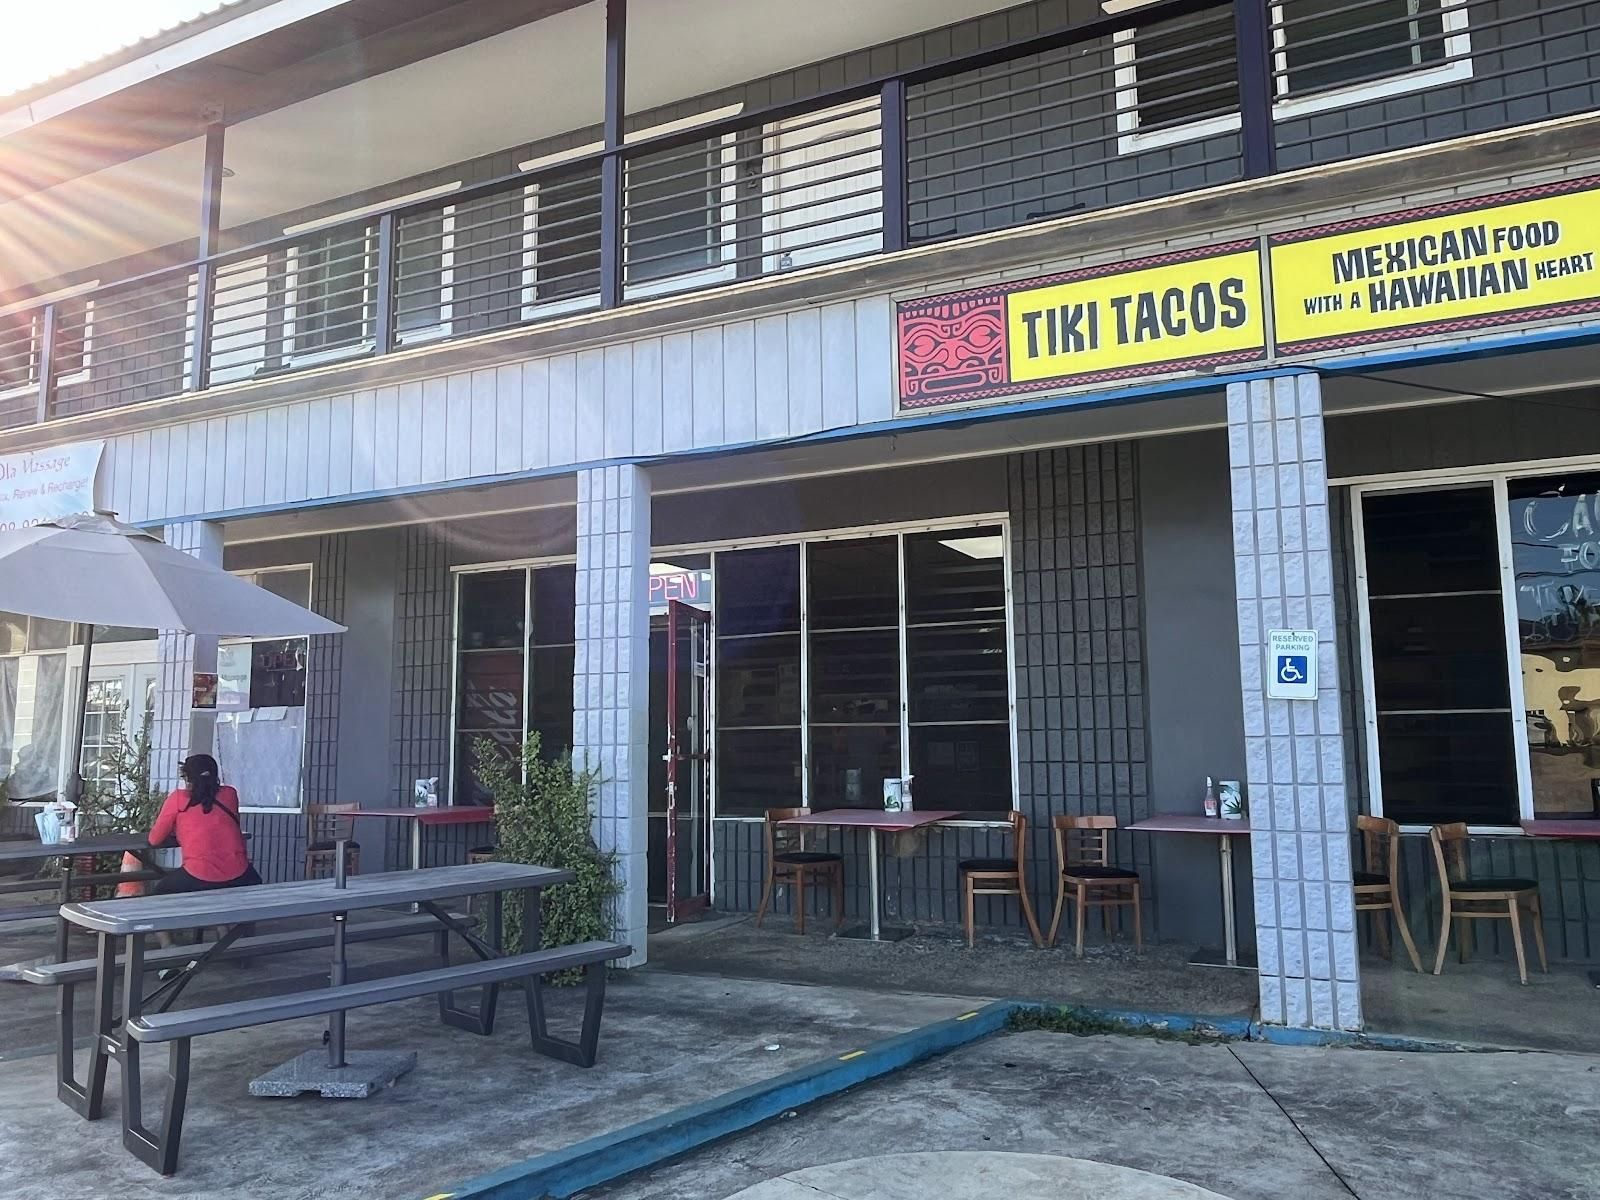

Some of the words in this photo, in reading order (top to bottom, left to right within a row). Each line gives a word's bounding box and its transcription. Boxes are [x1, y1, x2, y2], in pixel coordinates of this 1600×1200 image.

[1331, 224, 1488, 285] MEXICAN
[1492, 220, 1560, 254] FOOD
[1303, 293, 1343, 315] WITH
[1349, 291, 1362, 309] A
[1368, 257, 1529, 314] HAWAIIAN
[1534, 252, 1594, 281] HEART
[1021, 301, 1098, 359] TIKI
[1110, 277, 1246, 346] TACOS
[649, 573, 697, 601] PEN
[1272, 635, 1314, 643] RESERVED
[1275, 643, 1310, 651] PARKING
